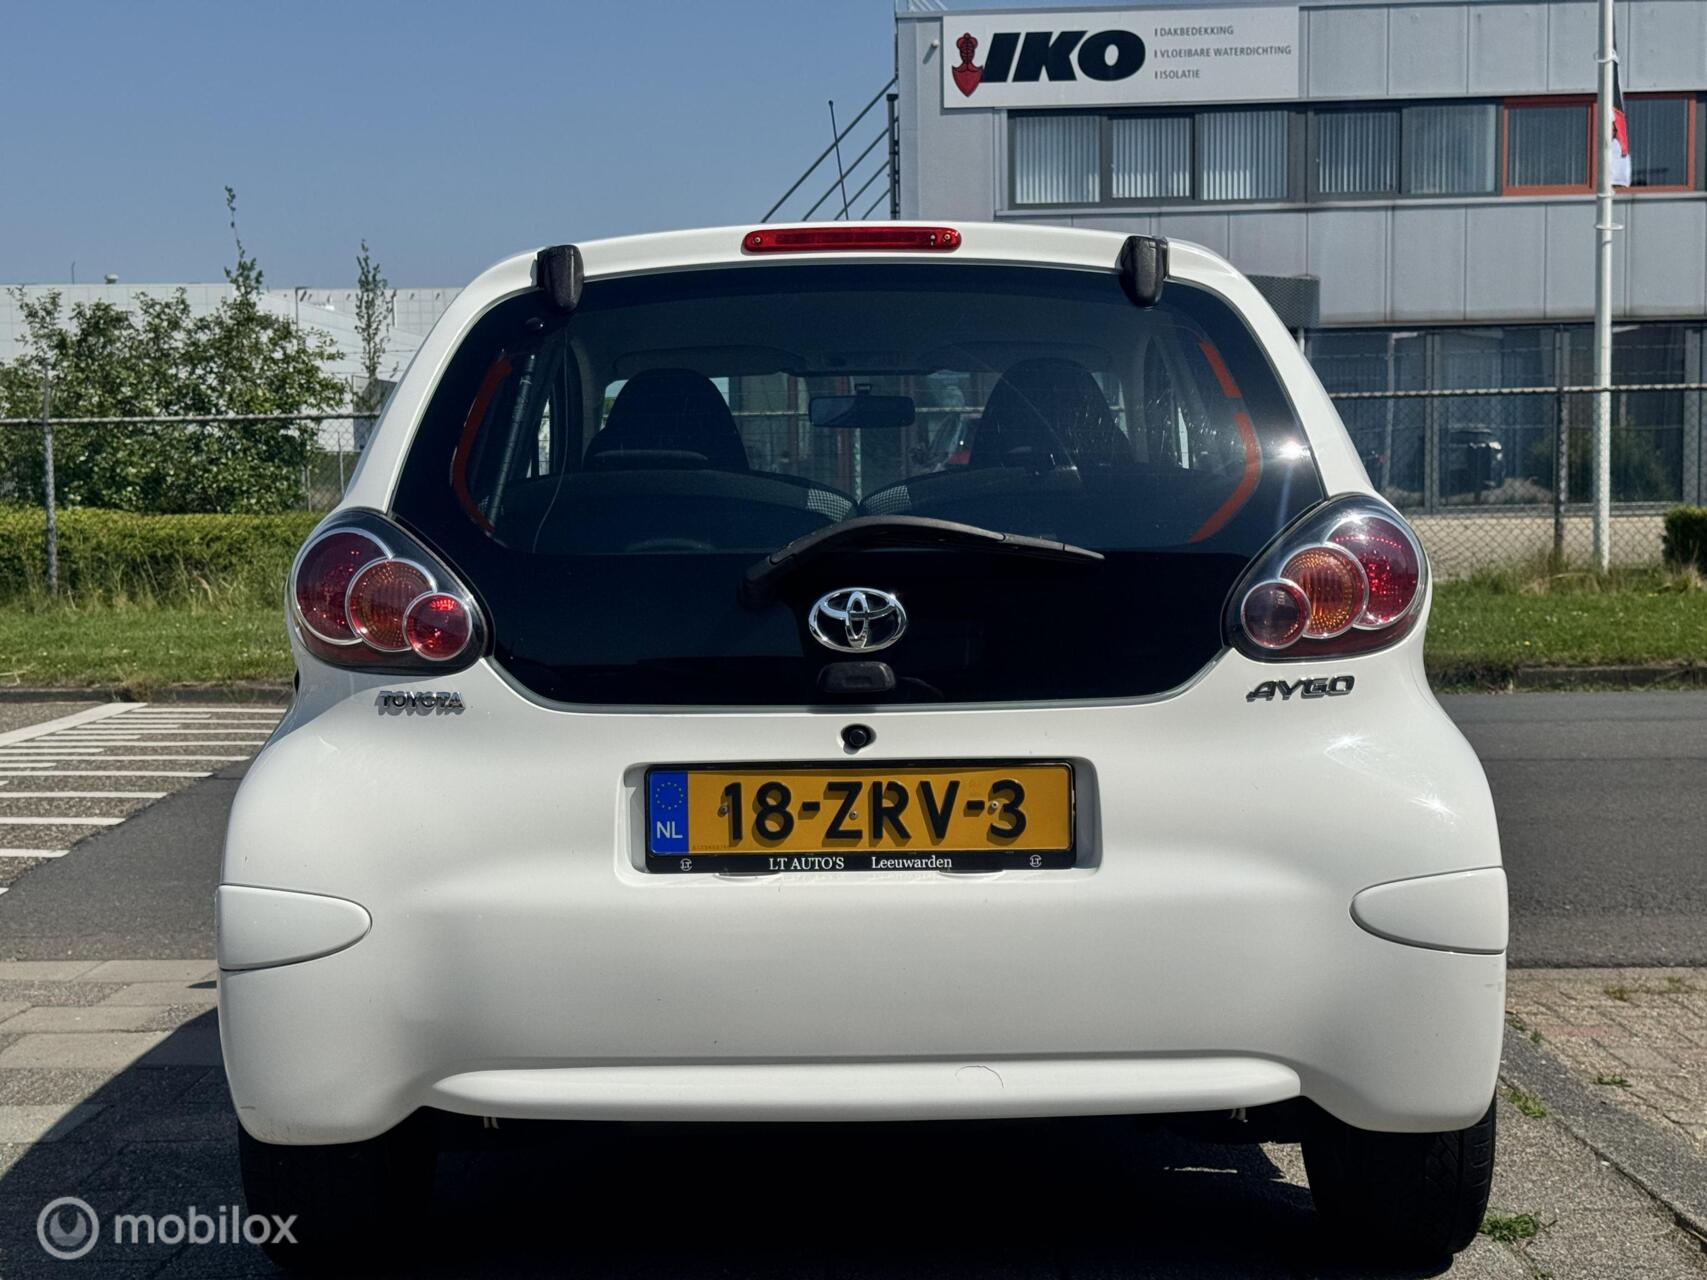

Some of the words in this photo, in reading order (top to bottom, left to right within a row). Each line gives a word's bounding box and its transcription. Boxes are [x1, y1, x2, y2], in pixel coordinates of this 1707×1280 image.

[1159, 25, 1234, 37] DAKBEDEKKING
[979, 29, 1146, 83] IKO
[1159, 47, 1211, 59] VLOEIBARE
[1213, 45, 1292, 57] WATERDICHTING
[1159, 69, 1200, 80] ISOLATIE
[1245, 675, 1355, 702] AYGO
[379, 690, 465, 710] TOYOTA
[722, 778, 1028, 842] 18-ZRV-3
[655, 819, 684, 840] NL
[768, 857, 788, 870] LT
[790, 856, 845, 870] AUTO'S
[871, 855, 953, 869] Leeuwarden
